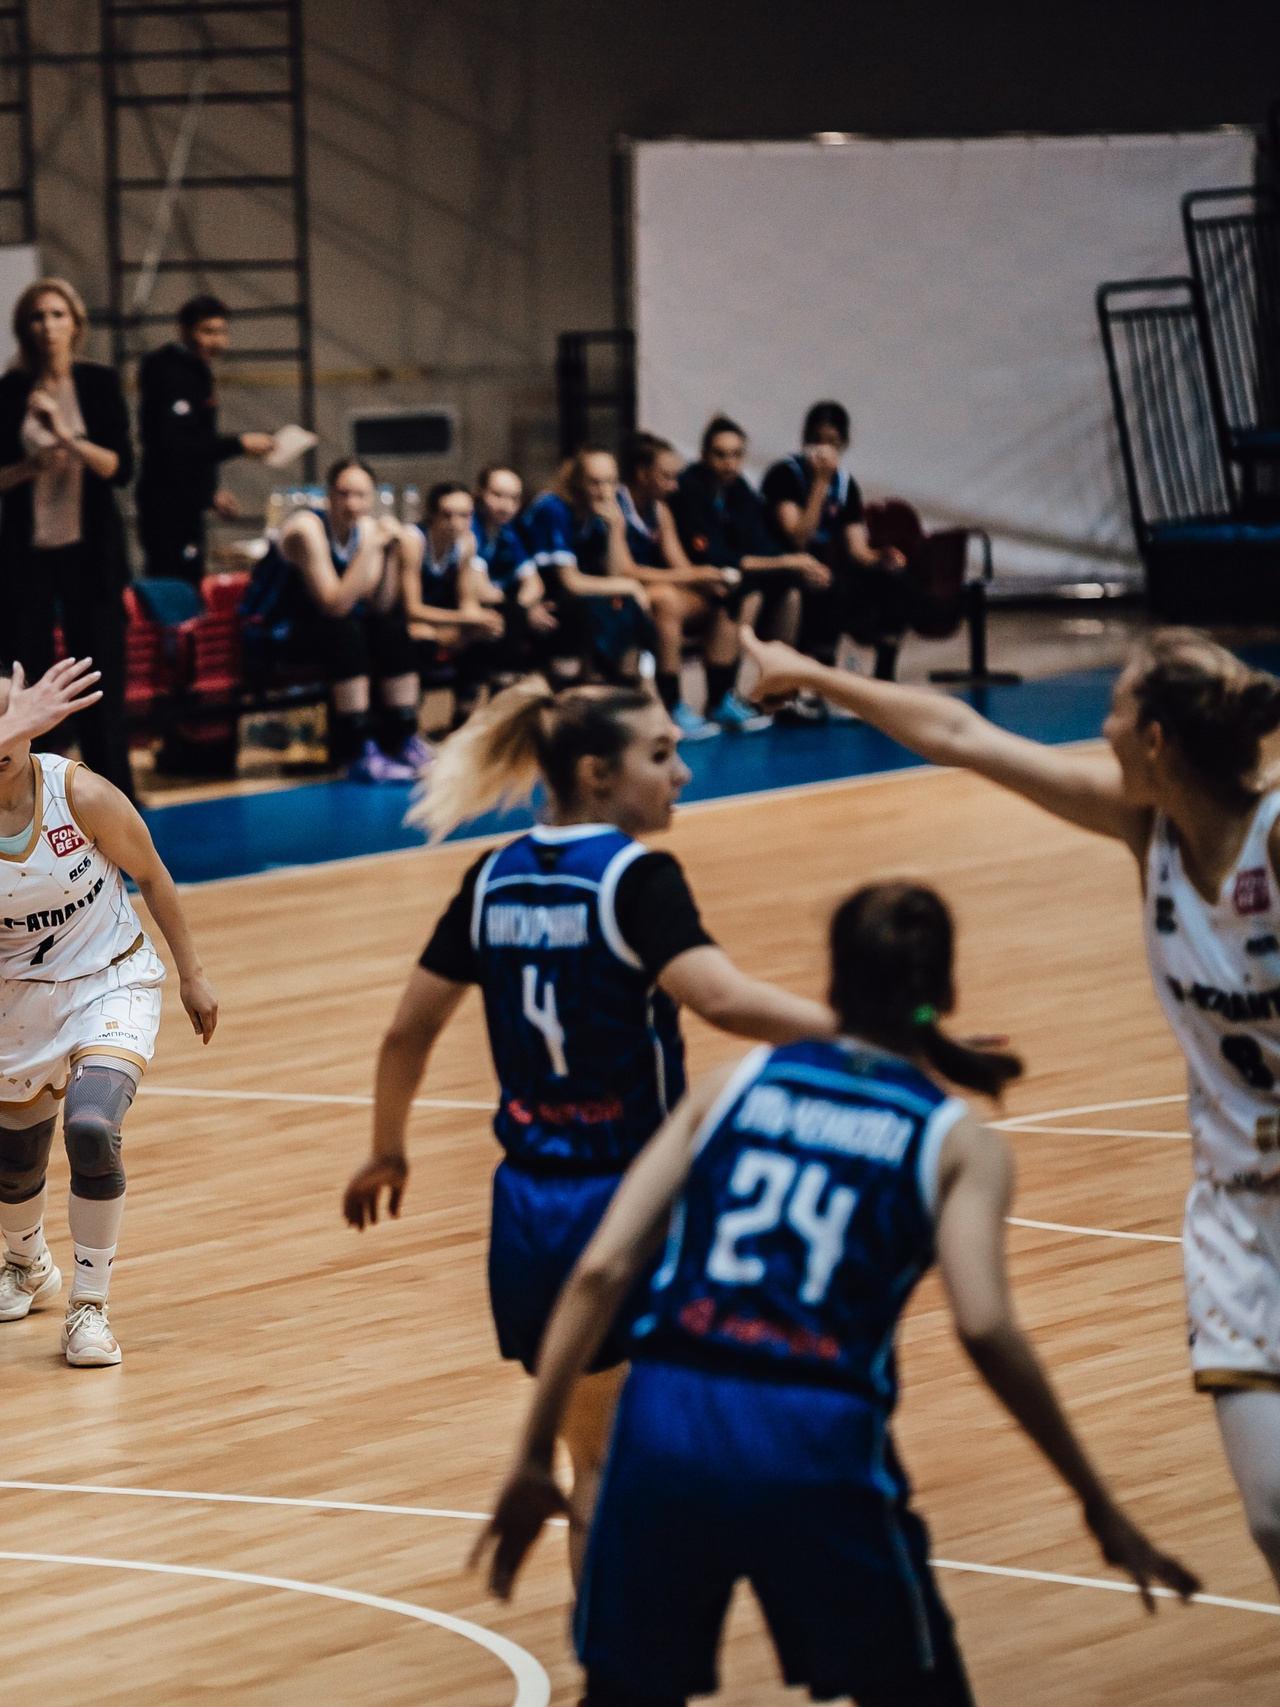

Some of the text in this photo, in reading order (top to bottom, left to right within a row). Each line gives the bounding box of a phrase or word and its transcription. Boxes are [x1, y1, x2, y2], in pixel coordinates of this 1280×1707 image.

[51, 828, 79, 845] FON
[56, 838, 81, 855] BET
[522, 964, 569, 1078] 4
[706, 1148, 859, 1305] 24
